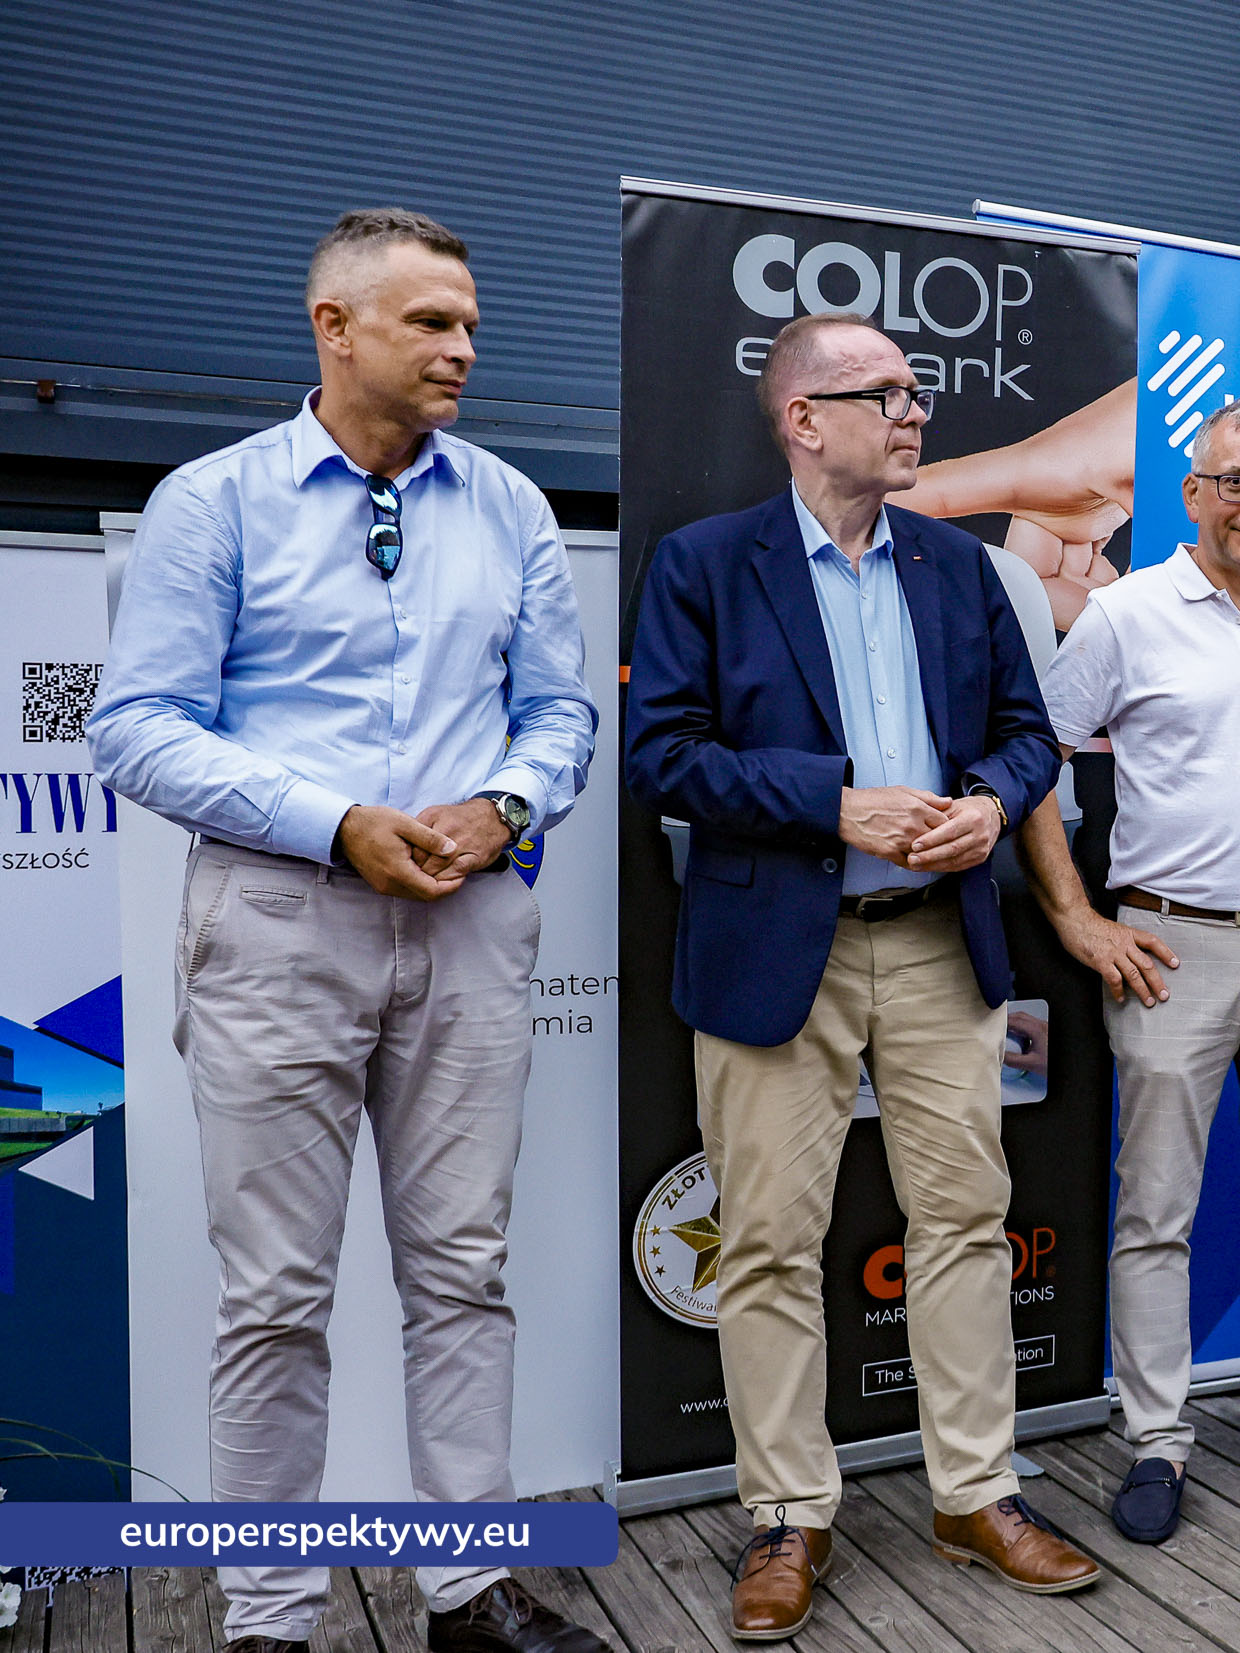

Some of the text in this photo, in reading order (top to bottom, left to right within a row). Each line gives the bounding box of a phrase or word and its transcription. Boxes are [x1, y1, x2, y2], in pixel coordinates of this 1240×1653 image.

[733, 233, 1033, 341] COLOP
[0, 847, 90, 870] SZŁOŚĆ
[661, 1165, 709, 1211] ZŁOT
[875, 1369, 904, 1384] The
